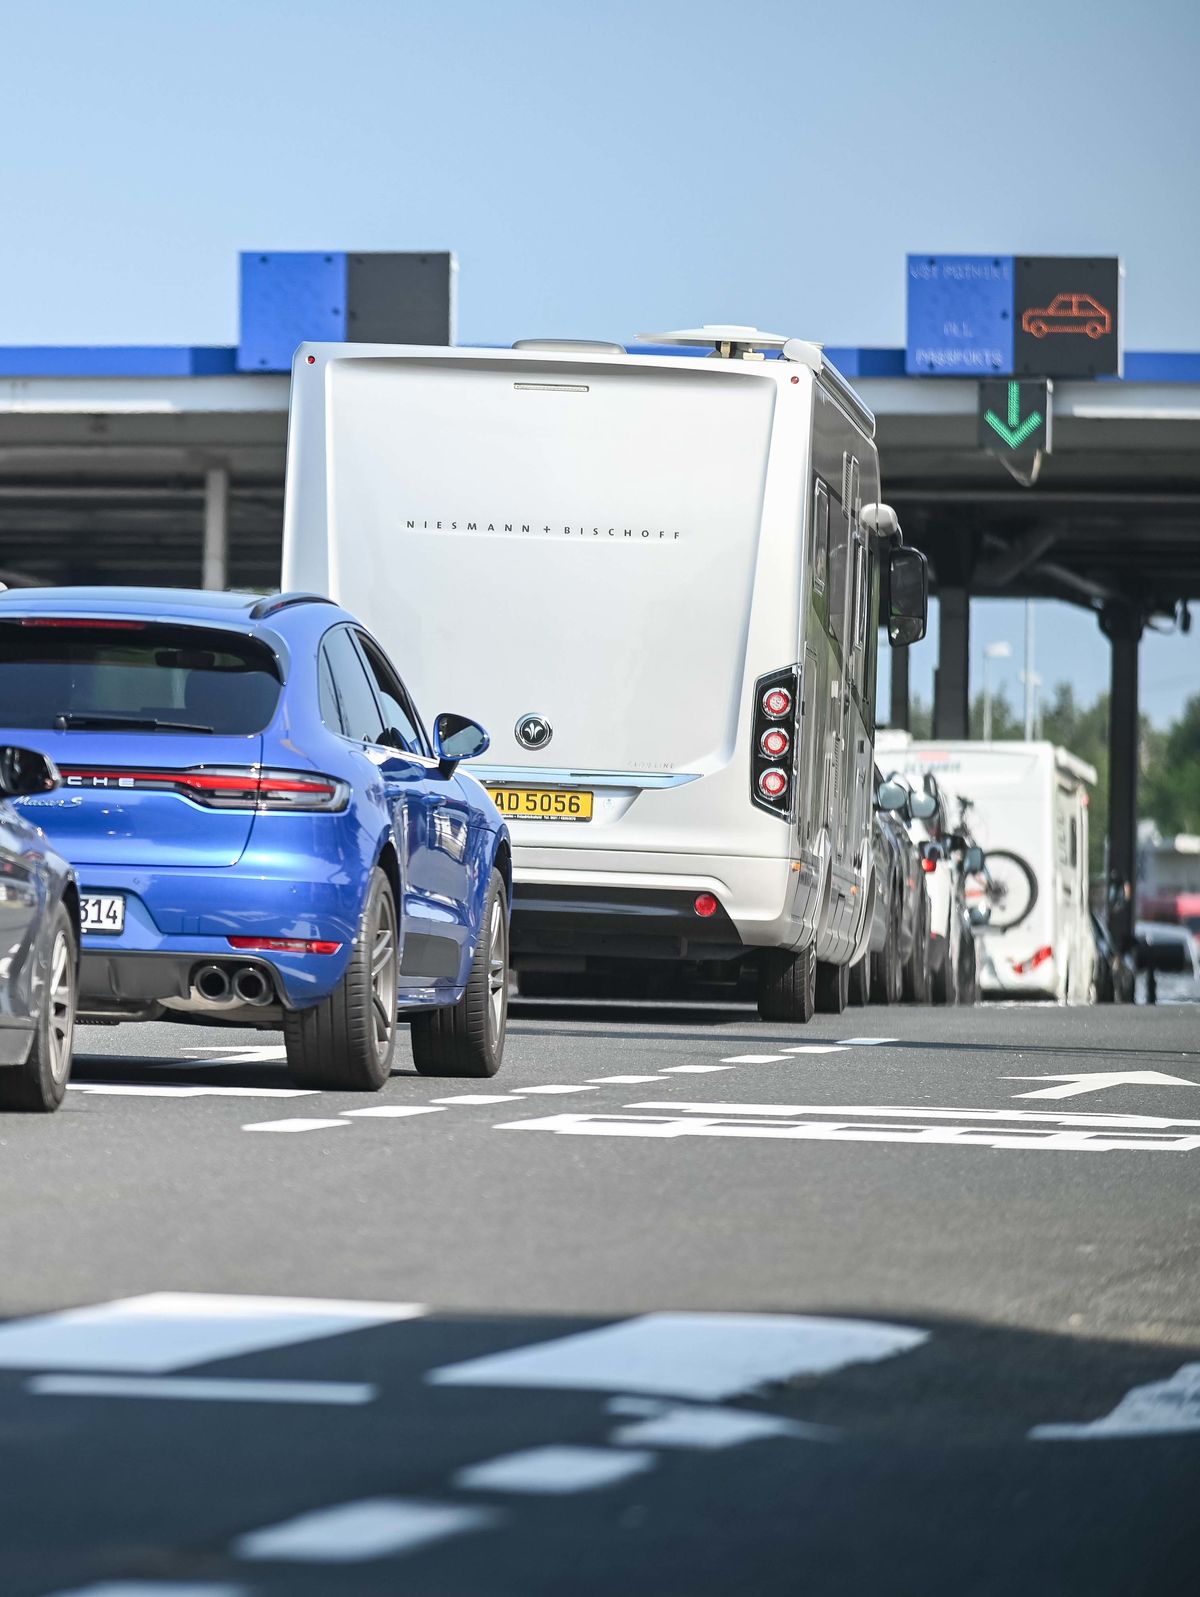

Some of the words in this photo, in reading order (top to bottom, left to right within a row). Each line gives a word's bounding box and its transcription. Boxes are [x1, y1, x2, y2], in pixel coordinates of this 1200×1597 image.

[407, 520, 530, 533] NIESMANN
[564, 526, 680, 540] BISCHOFF
[525, 793, 581, 813] 5056
